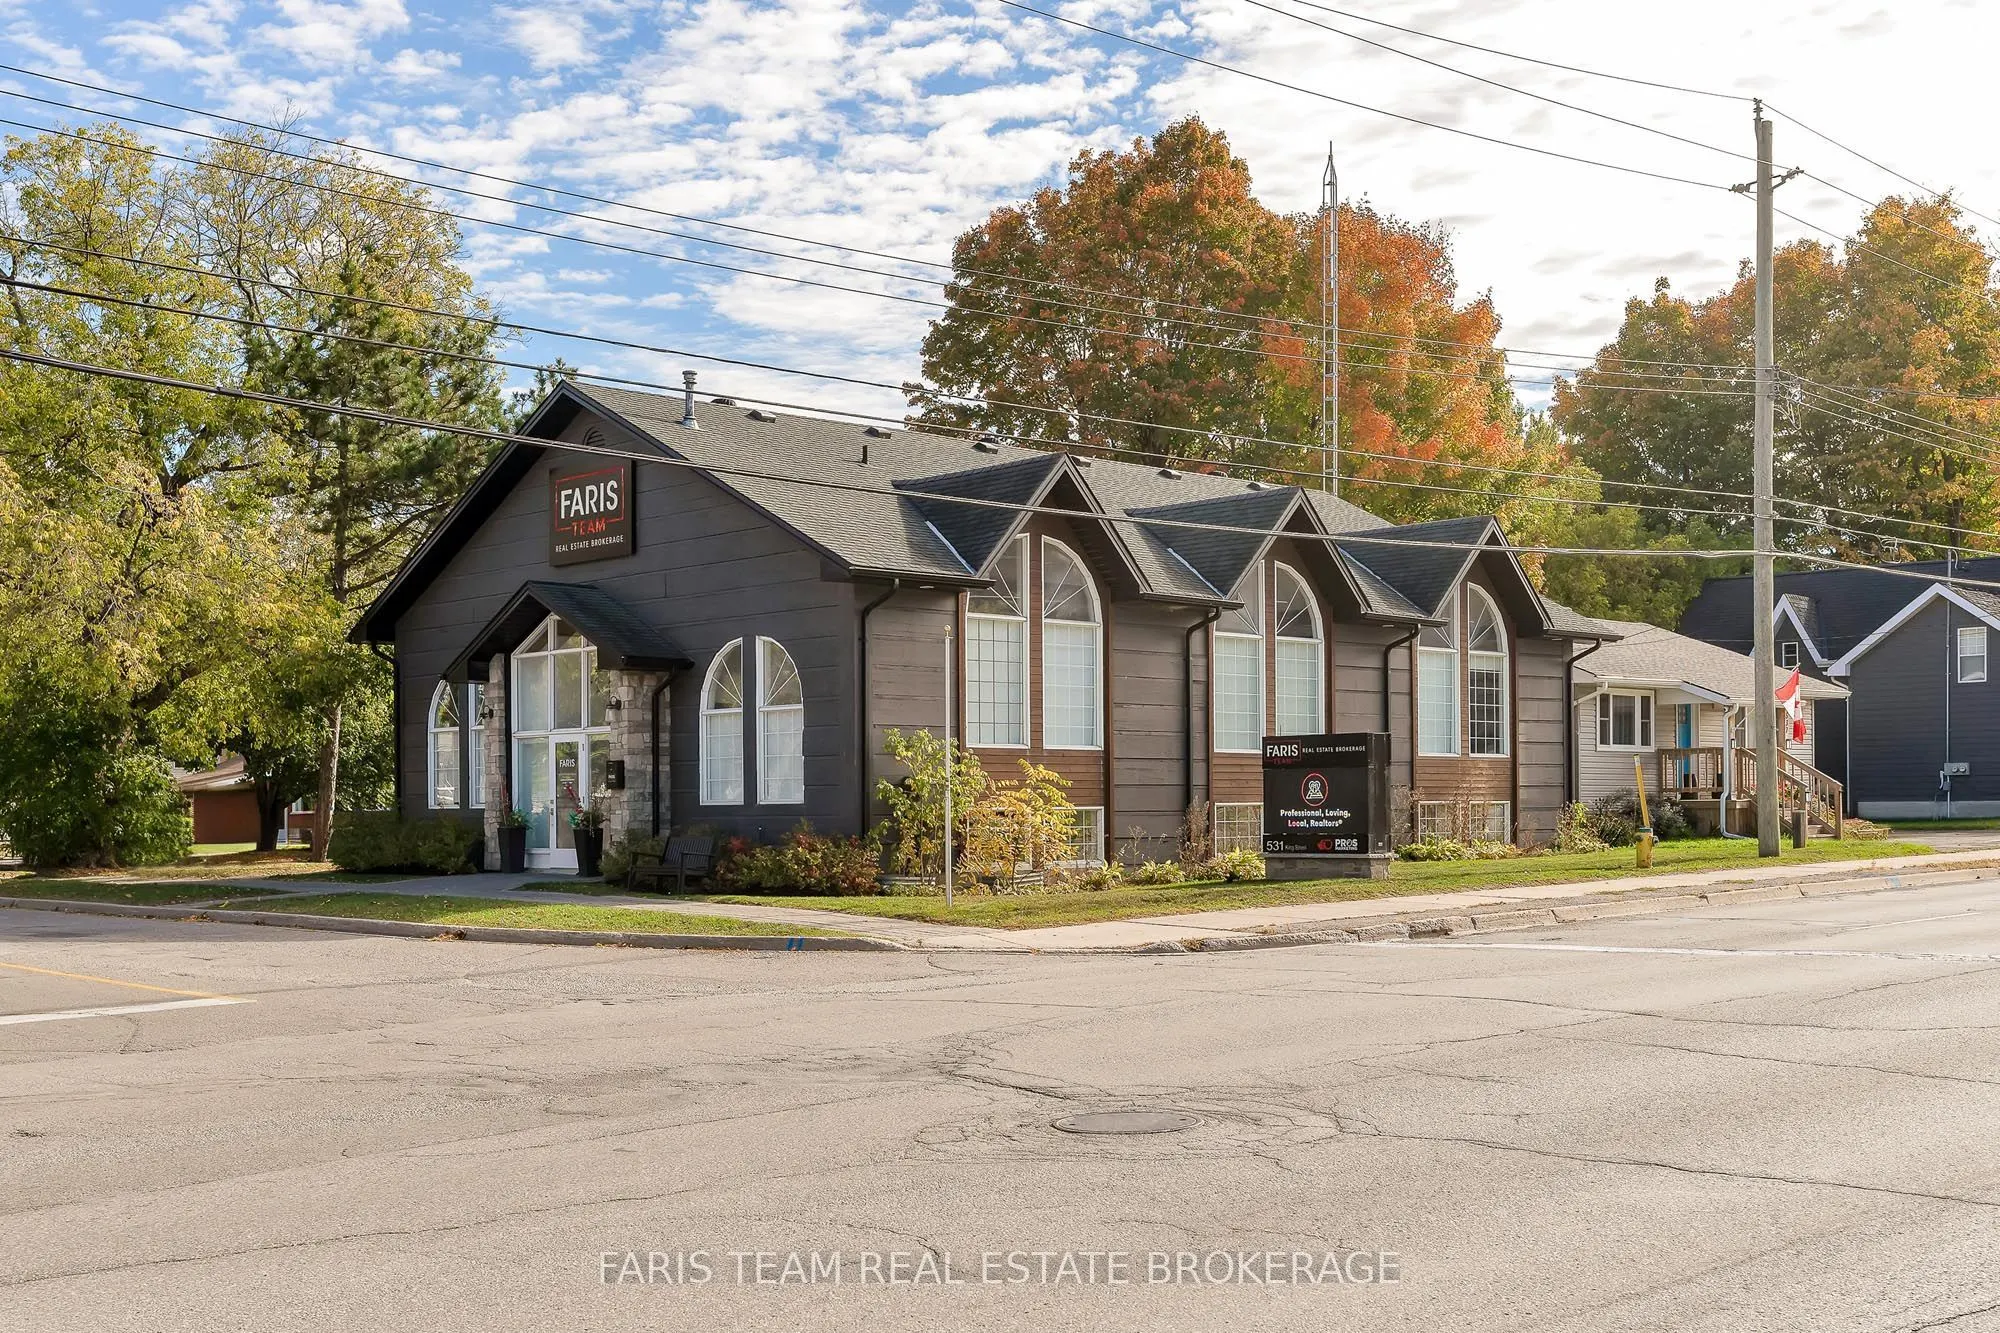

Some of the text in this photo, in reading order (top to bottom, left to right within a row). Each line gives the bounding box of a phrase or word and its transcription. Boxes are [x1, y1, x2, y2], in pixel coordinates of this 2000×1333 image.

[560, 480, 619, 519] FARIS
[572, 517, 606, 537] TEAM
[555, 534, 624, 553] REAL ESTATE BROKERAGE
[1266, 744, 1299, 757] FARIS
[559, 758, 576, 768] FARIS
[1280, 808, 1351, 818] Professional, Loving,
[1288, 819, 1309, 828] Local,
[1266, 840, 1284, 851] 531
[1334, 838, 1358, 847] PROS
